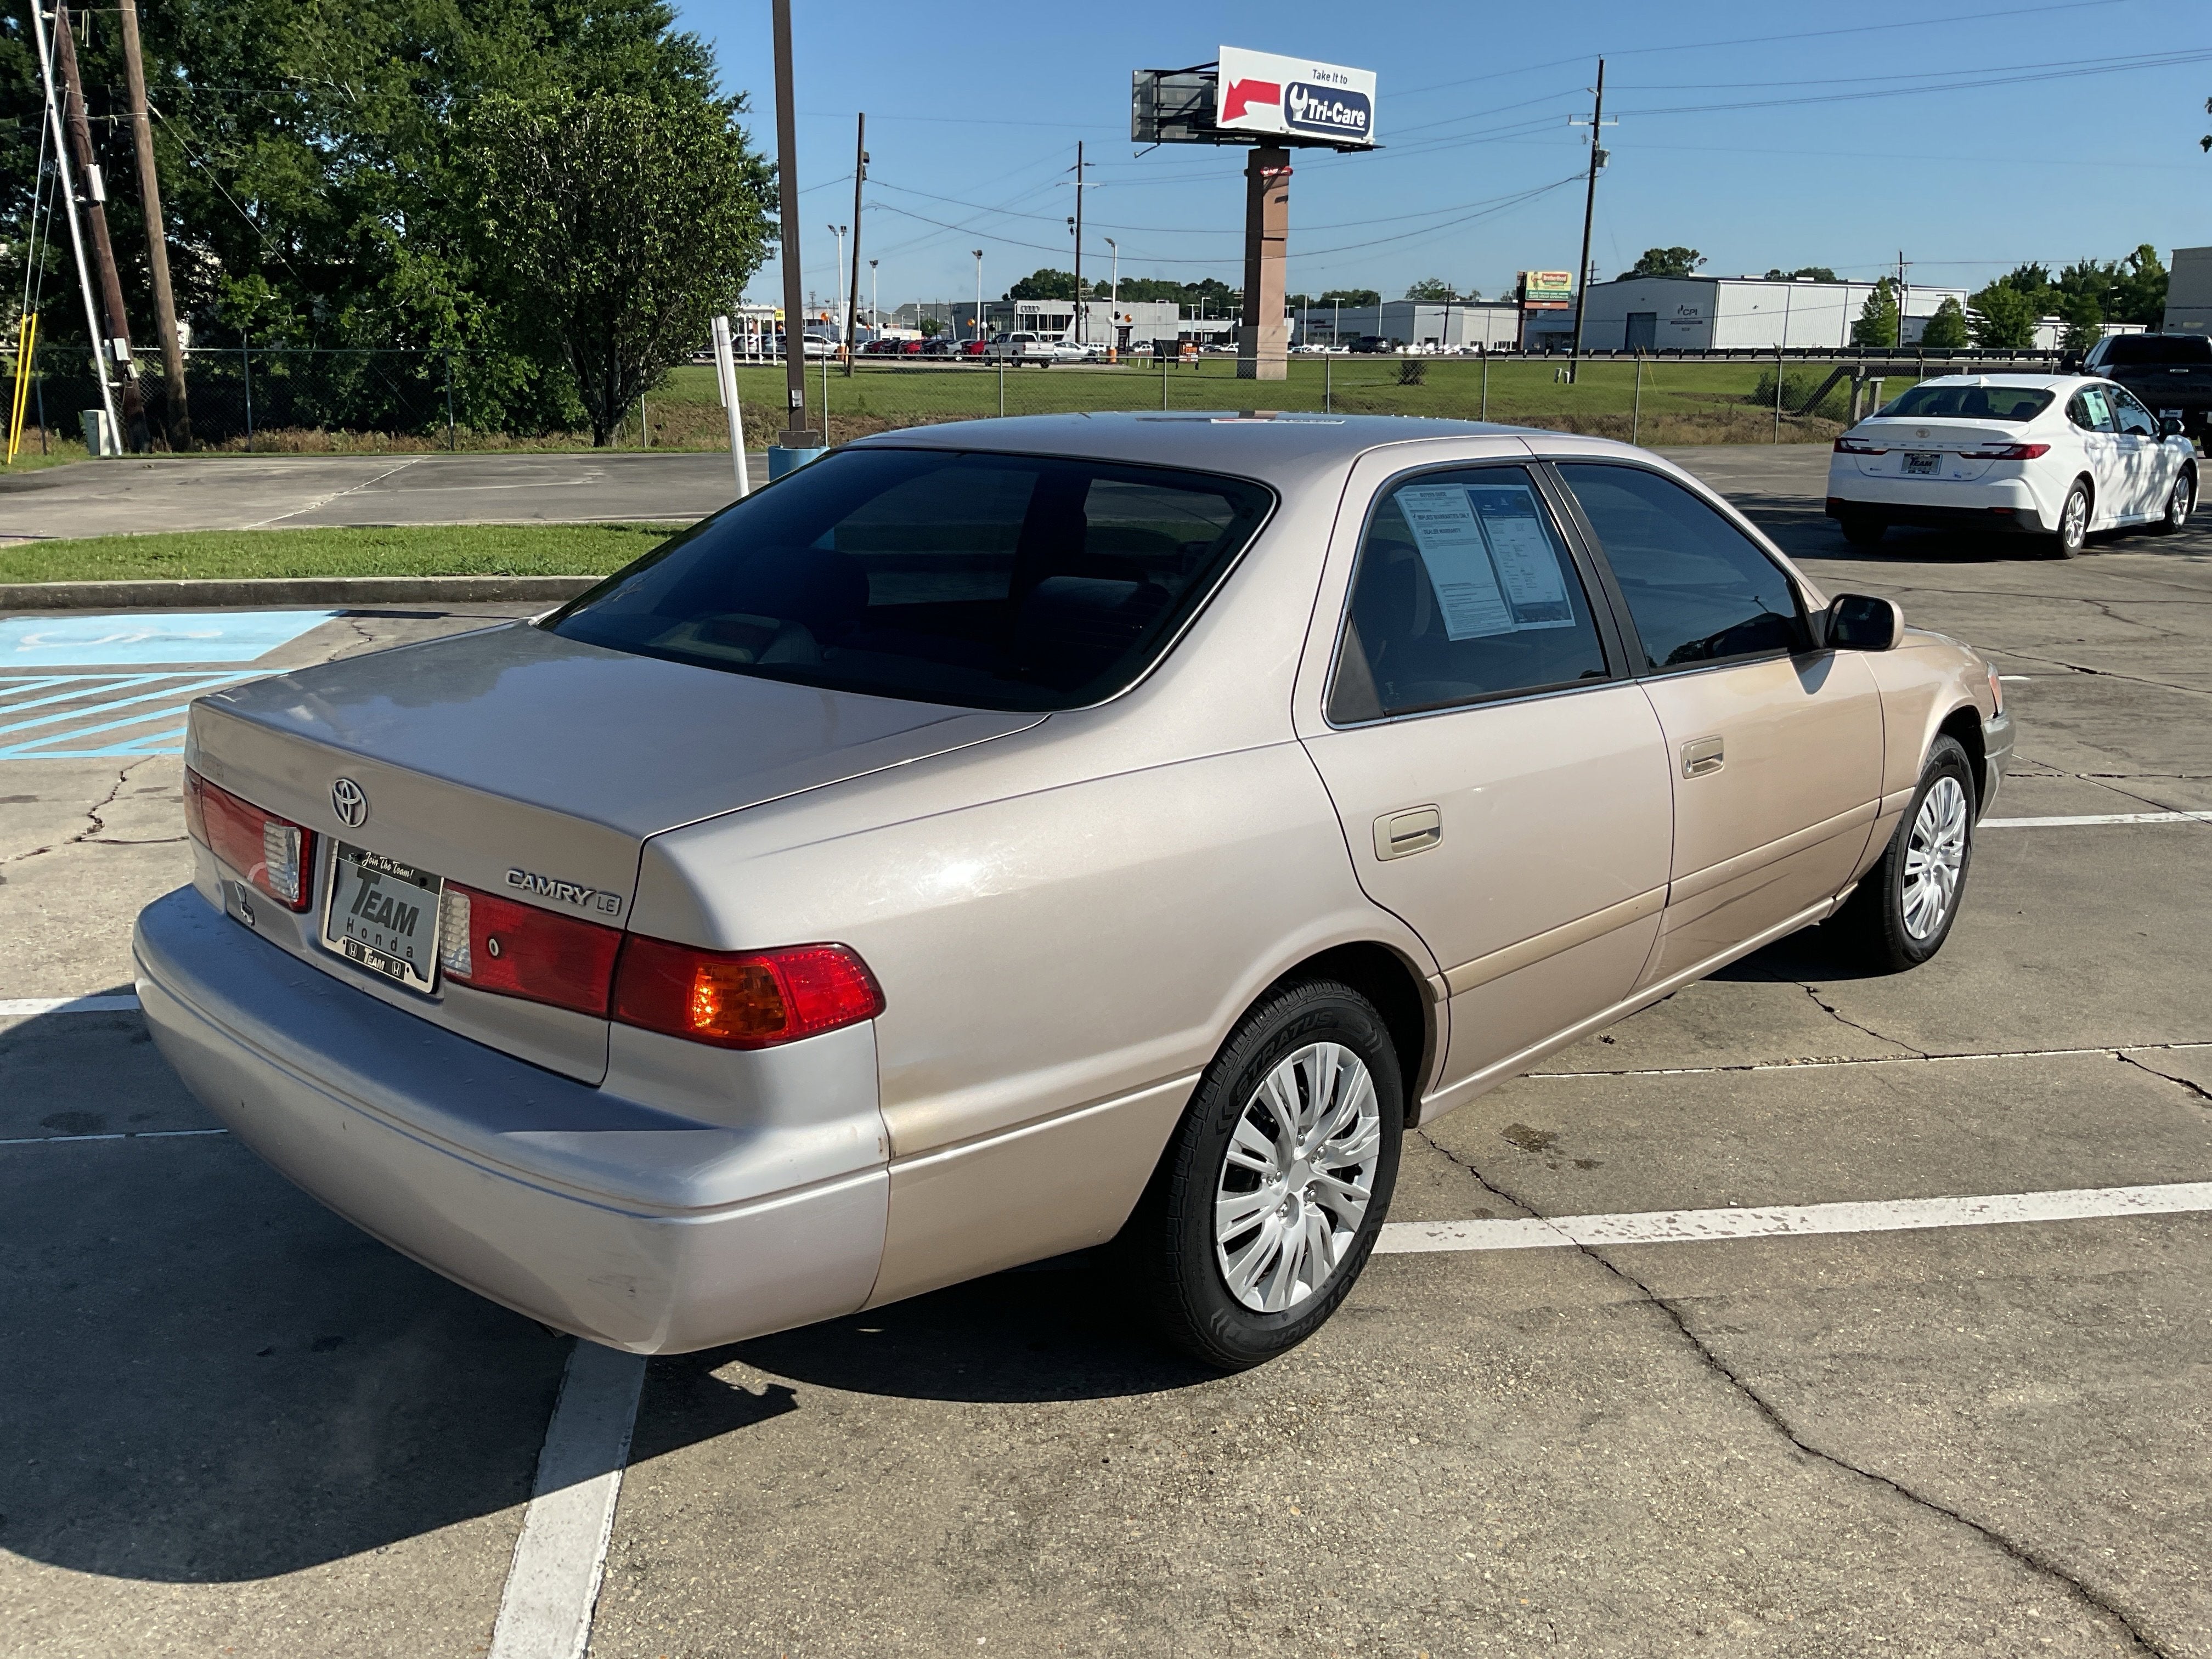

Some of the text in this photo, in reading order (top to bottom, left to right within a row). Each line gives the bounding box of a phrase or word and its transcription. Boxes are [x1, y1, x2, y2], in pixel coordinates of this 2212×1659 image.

[1313, 69, 1347, 84] Take It to
[1308, 98, 1365, 126] Tri-Care
[362, 851, 414, 879] Join The Team!
[351, 867, 420, 937] TEAM
[505, 868, 616, 912] CAMRY LE
[346, 917, 414, 958] Honda
[364, 947, 385, 970] TEAM
[1235, 1010, 1334, 1098] STRATUS
[1225, 1232, 1375, 1346] MASTERCRT
